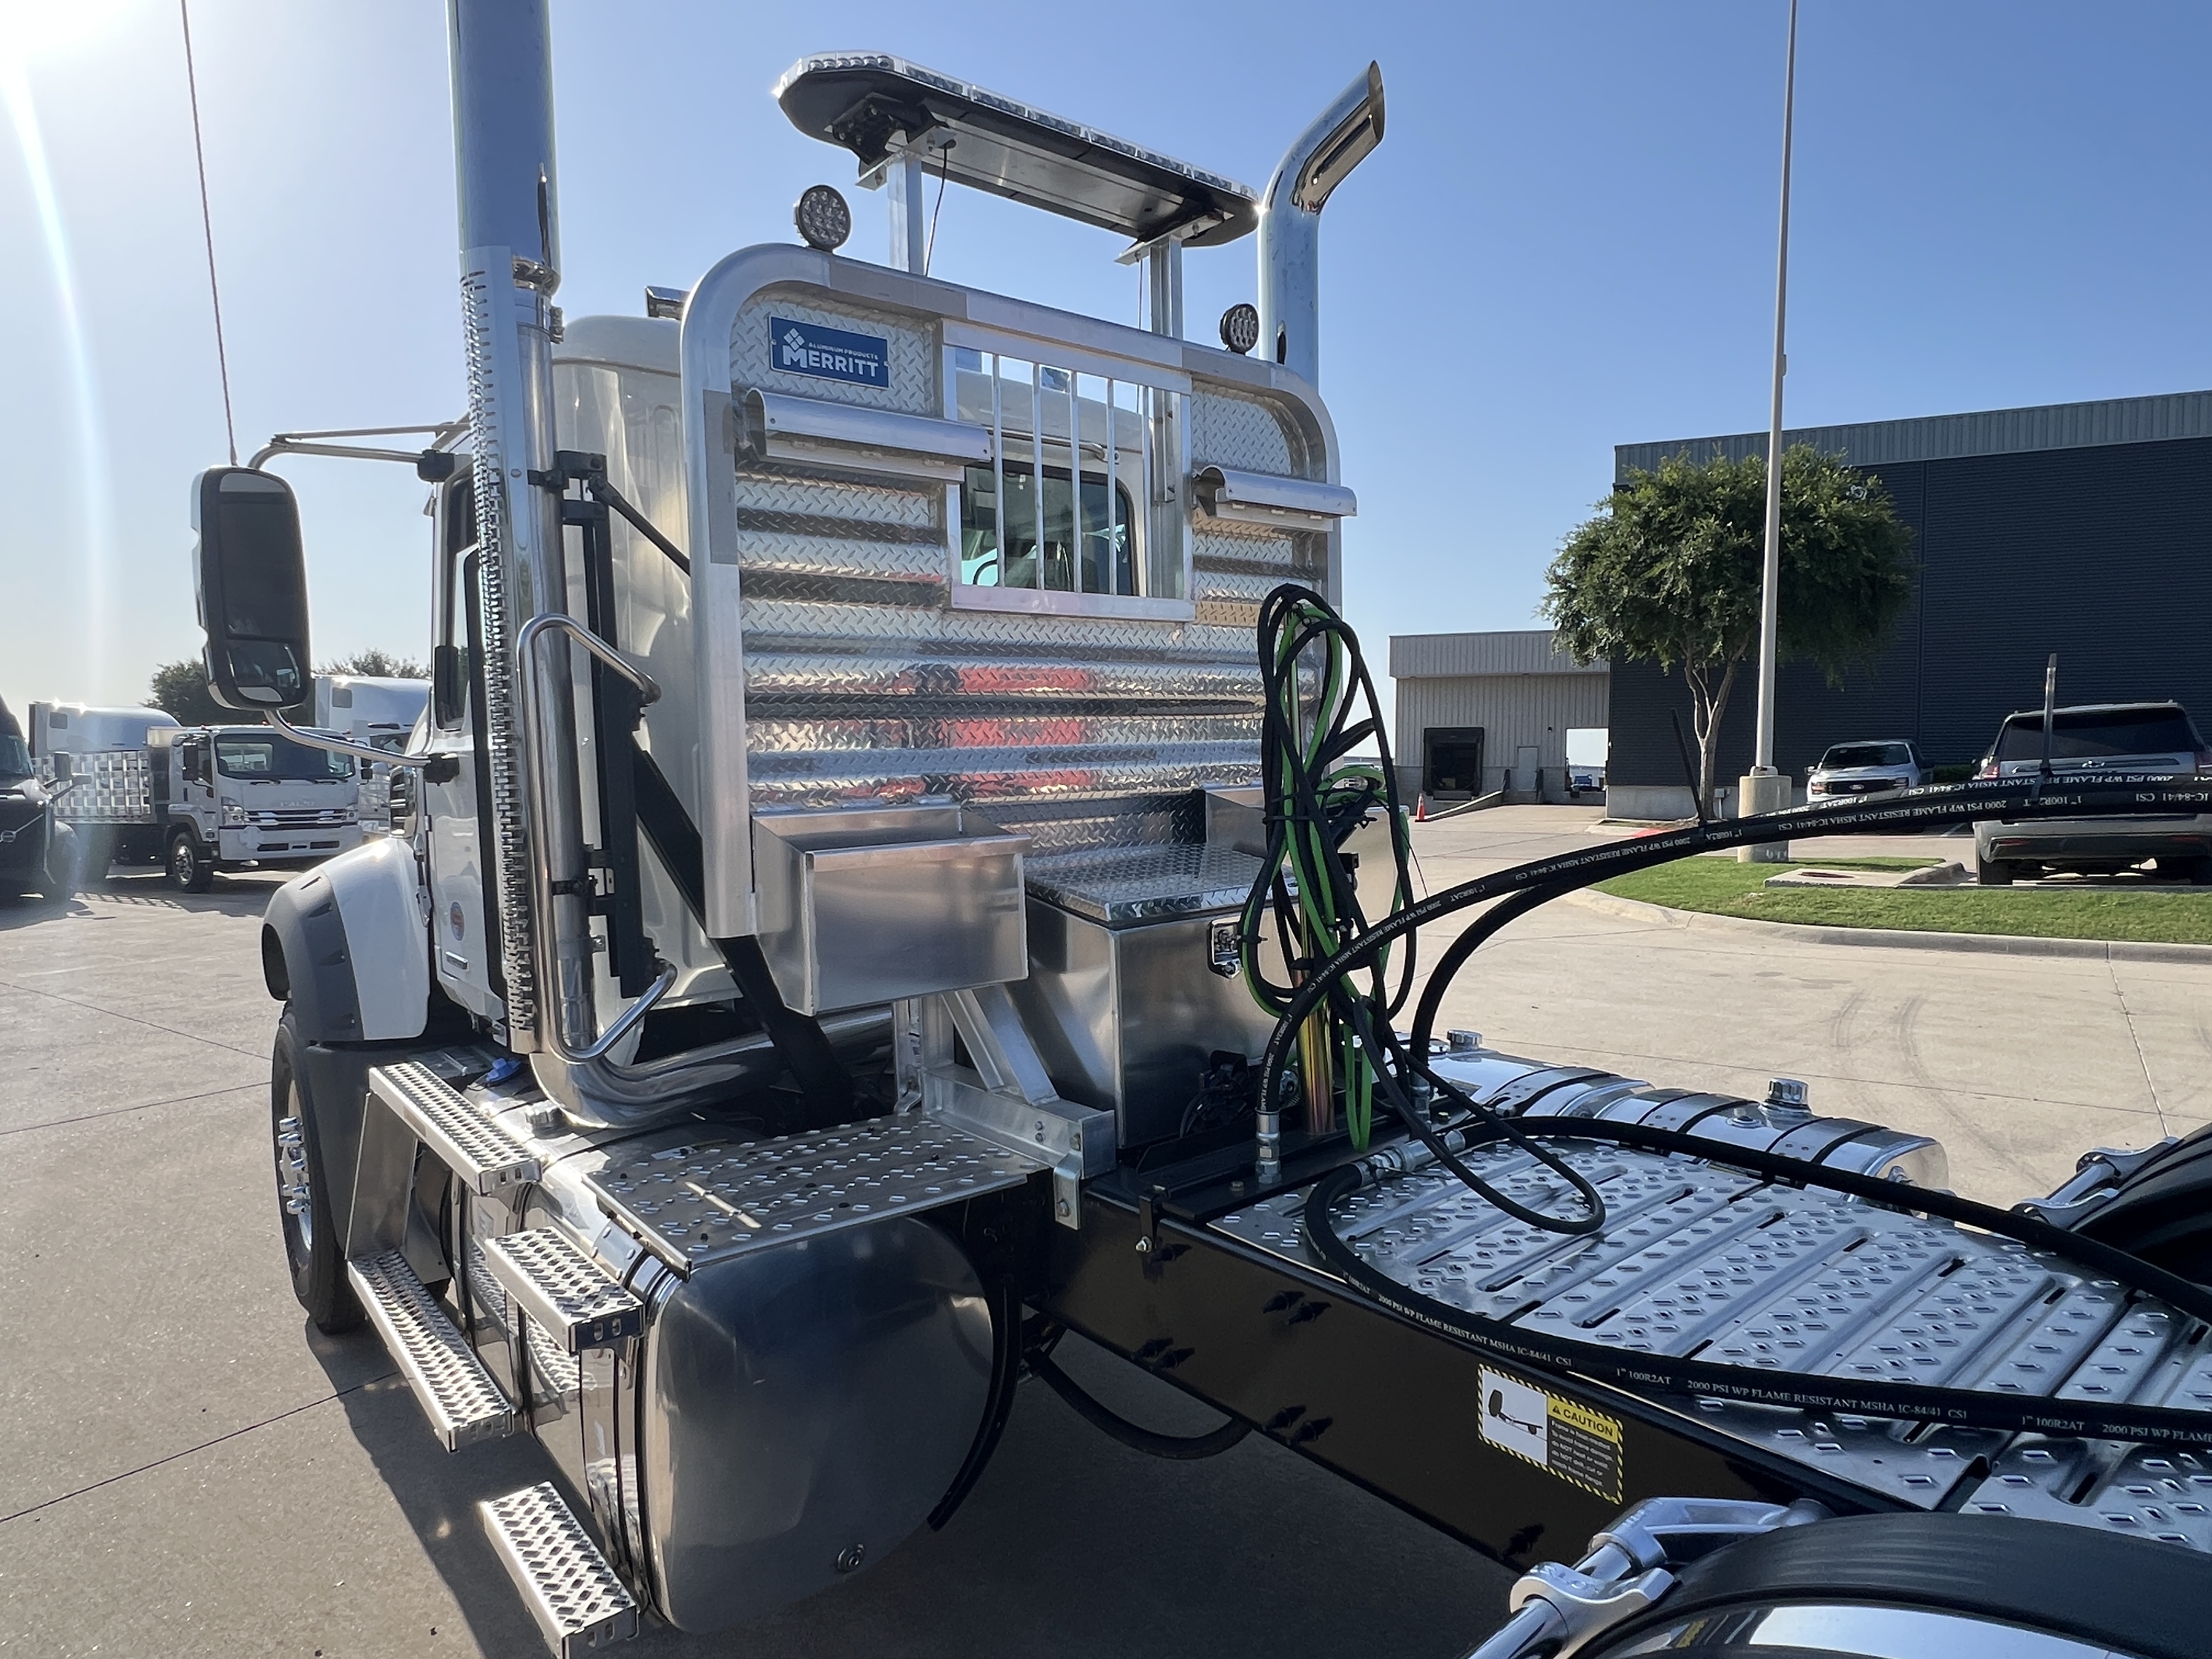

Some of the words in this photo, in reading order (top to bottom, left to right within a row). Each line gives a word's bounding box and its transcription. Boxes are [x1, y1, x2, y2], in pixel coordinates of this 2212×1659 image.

[808, 342, 844, 353] ALUMINUM
[844, 349, 878, 360] PRODUCTS
[782, 345, 878, 377] MERRITT
[2135, 793, 2155, 802] CSI
[2163, 792, 2209, 801] IC-84/41
[1913, 805, 1947, 816] FLAME
[1949, 803, 1965, 812] WP
[1967, 802, 1983, 811] PSI
[1985, 800, 2006, 809] 2000
[1830, 815, 1857, 825] MSHA
[1858, 809, 1910, 822] RESISTANT
[1648, 843, 1661, 851] WP
[1662, 839, 1674, 848] PSI
[1674, 837, 1691, 845] 2000
[1622, 845, 1647, 856] FLAME
[1579, 850, 1620, 865] RESISTANT
[1557, 859, 1579, 870] MSHA
[1384, 918, 1406, 933] FLAME
[1352, 929, 1384, 953] RESISTANT
[1378, 1293, 1392, 1307] 2000
[1391, 1301, 1403, 1312] PSI
[1403, 1306, 1415, 1318] WP
[1414, 1311, 1442, 1330] FLAME
[1443, 1322, 1488, 1345] RESISTANT
[1489, 1339, 1516, 1354] MSHA
[1517, 1346, 1551, 1362] IC-84/41
[1556, 1356, 1572, 1367] CSI
[1629, 1370, 1672, 1385] 100R2AT
[1688, 1380, 1710, 1391] 2000
[1713, 1384, 1729, 1393] PSI
[1731, 1386, 1749, 1396] WP
[1752, 1389, 1792, 1402] FLAME
[1794, 1394, 1858, 1409] RESISTANT
[1861, 1400, 1895, 1412] MSHA
[1899, 1404, 1940, 1417] IC-84/41
[1948, 1409, 1967, 1420] CSI
[1564, 1408, 1613, 1437] CAUTION
[2036, 1417, 2085, 1431] 100R2AT
[2102, 1424, 2128, 1434] 2000
[2130, 1426, 2148, 1436] PSI
[2151, 1428, 2170, 1438] WP
